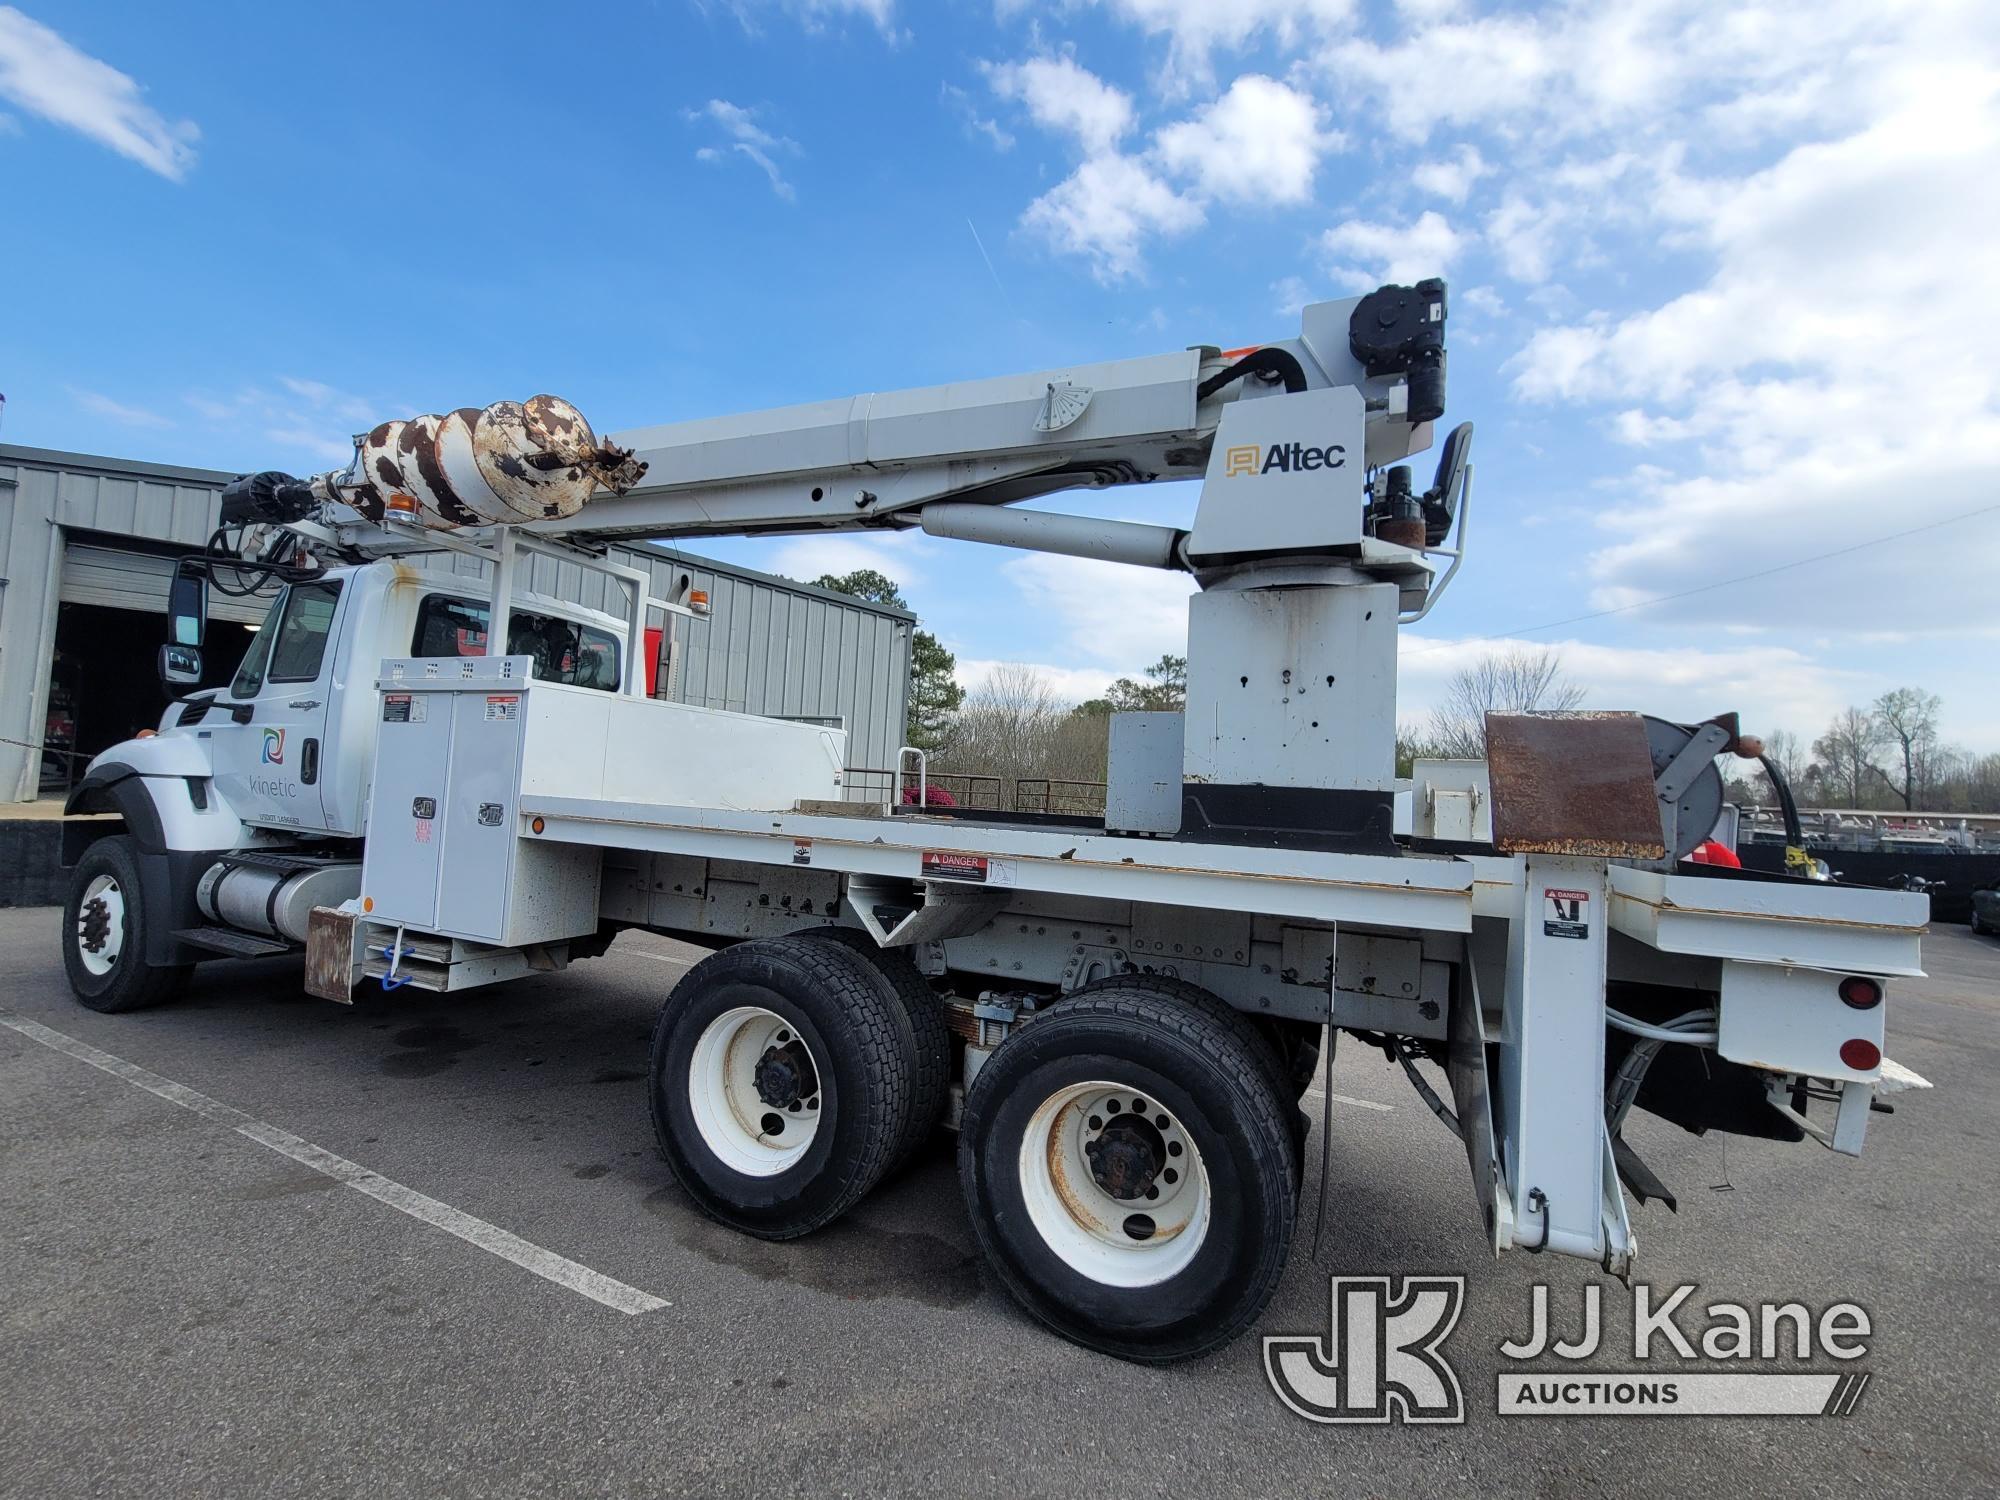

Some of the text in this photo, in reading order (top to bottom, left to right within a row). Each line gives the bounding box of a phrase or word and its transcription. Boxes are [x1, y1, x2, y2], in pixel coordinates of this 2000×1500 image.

[1261, 442, 1346, 475] Altec
[249, 775, 297, 798] kinetic
[942, 855, 979, 867] DANGER
[1557, 891, 1585, 899] DANGER
